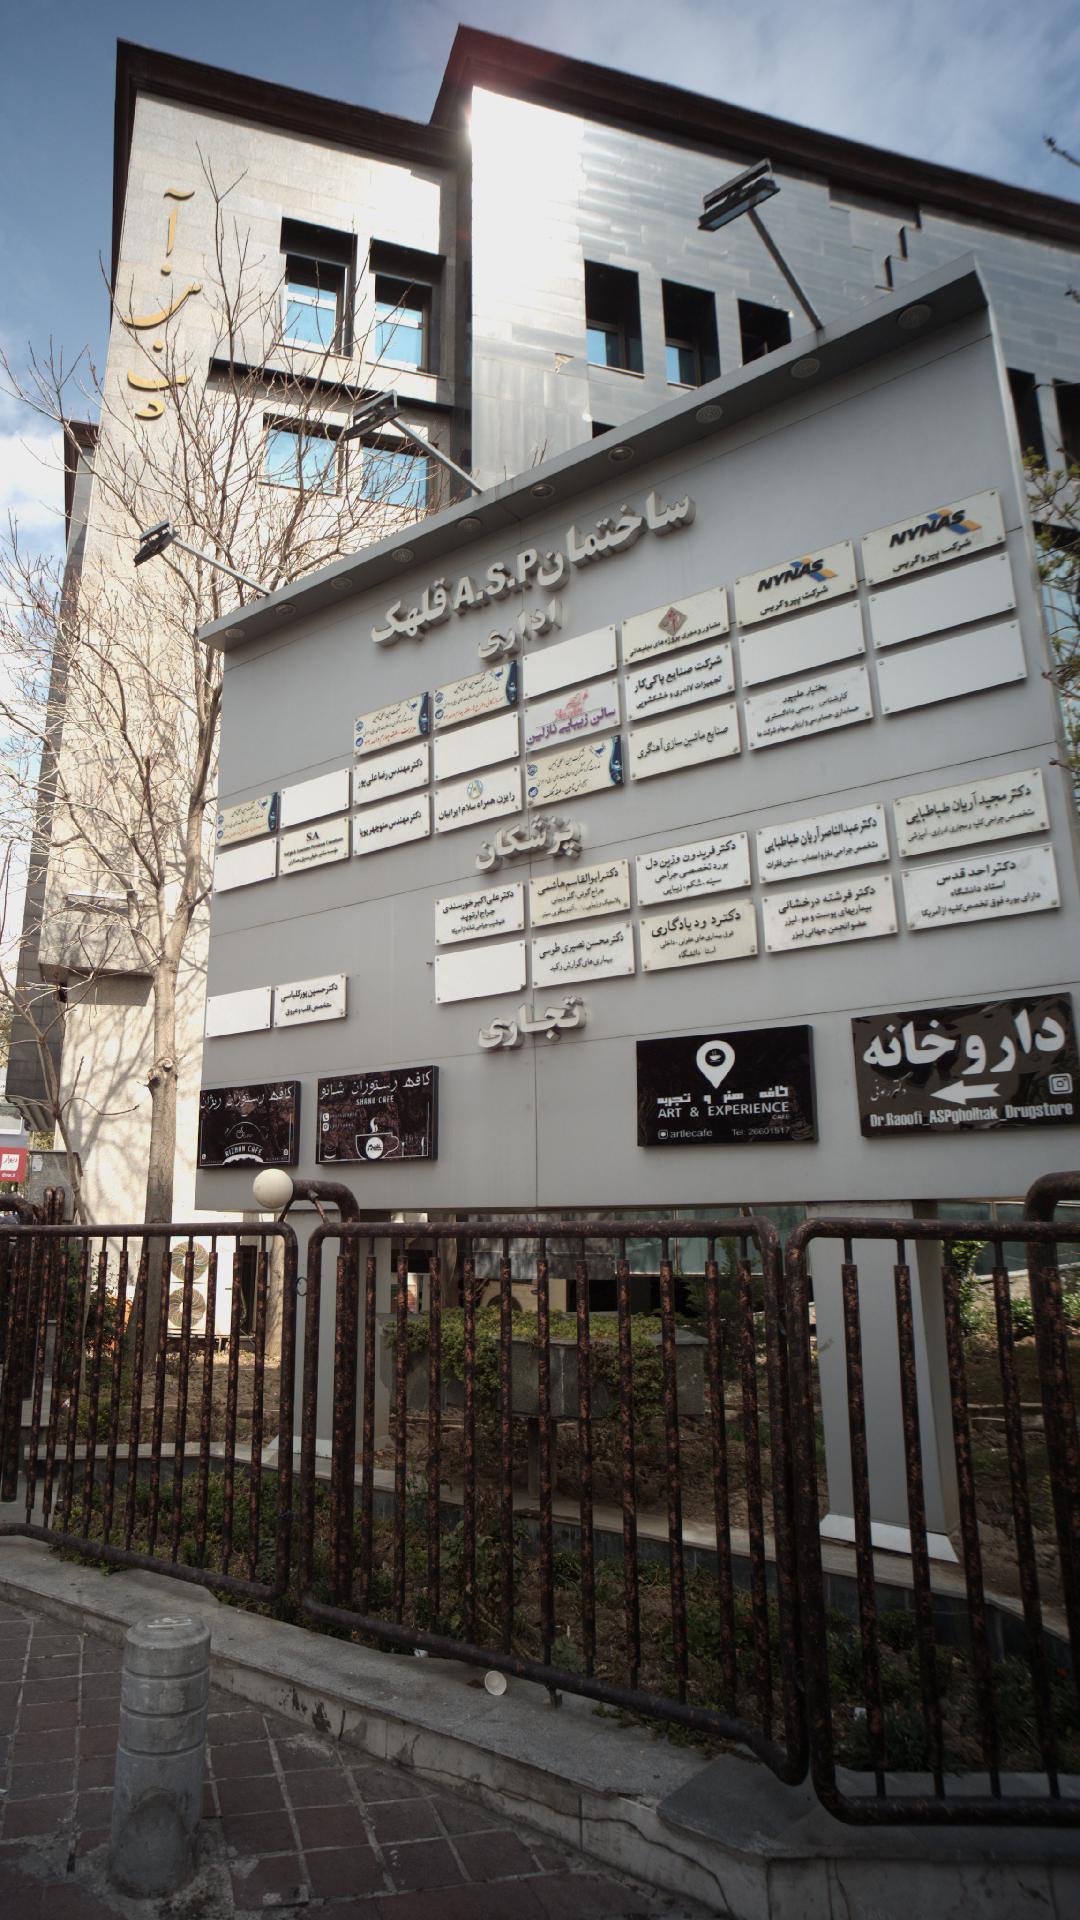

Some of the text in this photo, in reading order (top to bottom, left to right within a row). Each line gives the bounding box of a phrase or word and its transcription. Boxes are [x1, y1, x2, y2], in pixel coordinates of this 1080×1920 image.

[889, 509, 966, 548] NYNAS
[941, 538, 972, 555] شرکت
[371, 489, 695, 647] ساختمان A.S.P قلهک
[757, 558, 824, 592] NYNAS
[802, 585, 829, 600] شرکت
[478, 599, 562, 660] اداری
[694, 656, 723, 672] شرکت
[666, 666, 693, 683] صنایع
[694, 675, 722, 690] تجهیزات
[558, 712, 589, 735] زیبایی
[590, 707, 616, 727] سالن
[683, 731, 706, 748] ماشین
[706, 726, 729, 743] صنایع
[663, 738, 683, 752] سازی
[388, 765, 410, 780] مهندس
[408, 758, 424, 773] دکتر
[978, 794, 1007, 809] مجید
[1006, 784, 1032, 804] دکتر
[408, 810, 422, 824] دکتر
[858, 817, 878, 834] دکتر
[475, 814, 577, 870] پزشکان
[714, 840, 736, 856] دکتر
[682, 845, 716, 863] فریدون
[598, 867, 619, 883] دکتر
[654, 870, 679, 884] جراحی
[936, 860, 1017, 886] دکتر احد قدس
[537, 877, 565, 896] هاشمی
[854, 886, 876, 901] دکتر
[950, 880, 1006, 897] استاد دانشگاه
[500, 890, 514, 902] دکتر
[822, 889, 853, 903] فرشته
[652, 908, 741, 938] دکتر یادگاری
[815, 912, 838, 920] پوست
[586, 938, 609, 951] محسن
[608, 931, 624, 946] دکتر
[324, 982, 338, 995] دکتر
[478, 996, 583, 1048] تجاری
[402, 1070, 432, 1088] کافه
[352, 1080, 397, 1095] رستوران
[759, 1085, 789, 1098] کافه
[378, 1095, 394, 1103] CAFE
[658, 1102, 789, 1118] ART & EXPERIENCE
